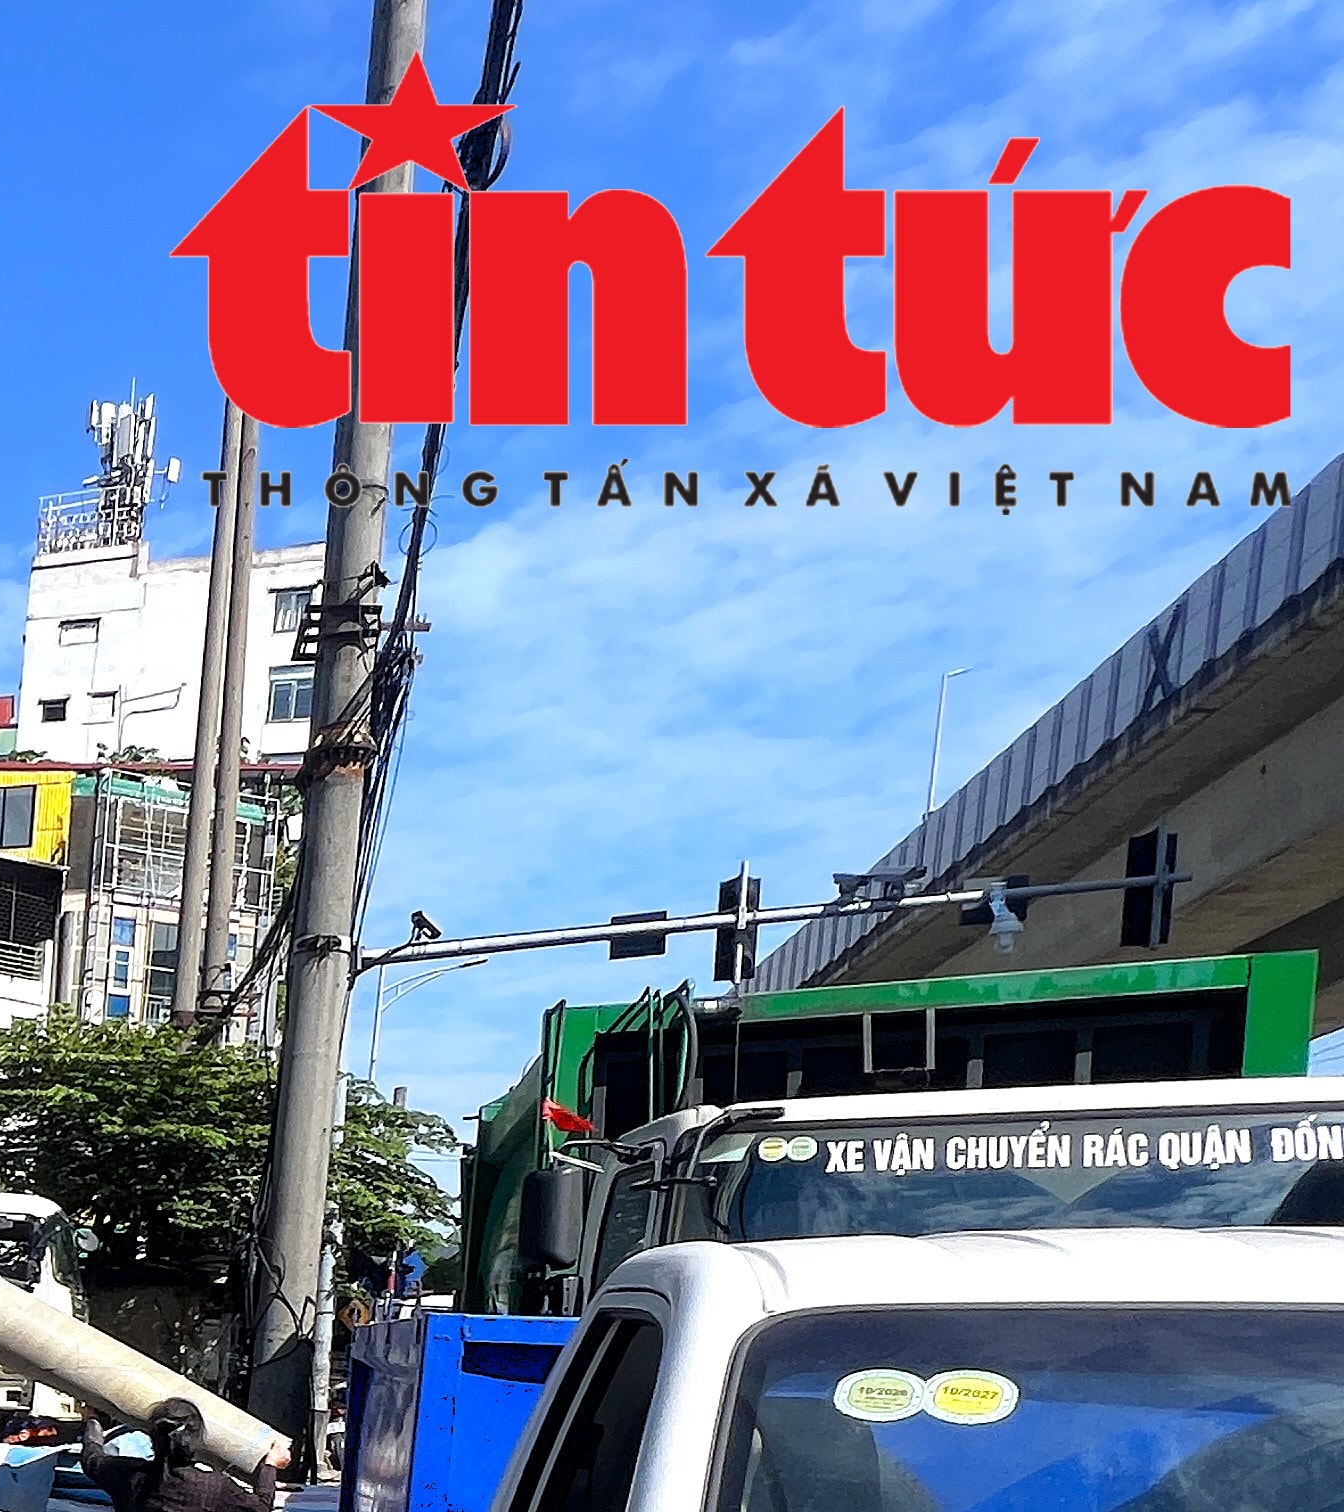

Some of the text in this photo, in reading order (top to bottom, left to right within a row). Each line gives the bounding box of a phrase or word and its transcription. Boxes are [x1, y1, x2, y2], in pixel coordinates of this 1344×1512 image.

[825, 1140, 865, 1173] XE
[872, 1132, 935, 1176] VẬN
[945, 1119, 1071, 1170] CHUYỂN
[1082, 1127, 1149, 1168] RÁC
[1158, 1123, 1253, 1170] QUẬN
